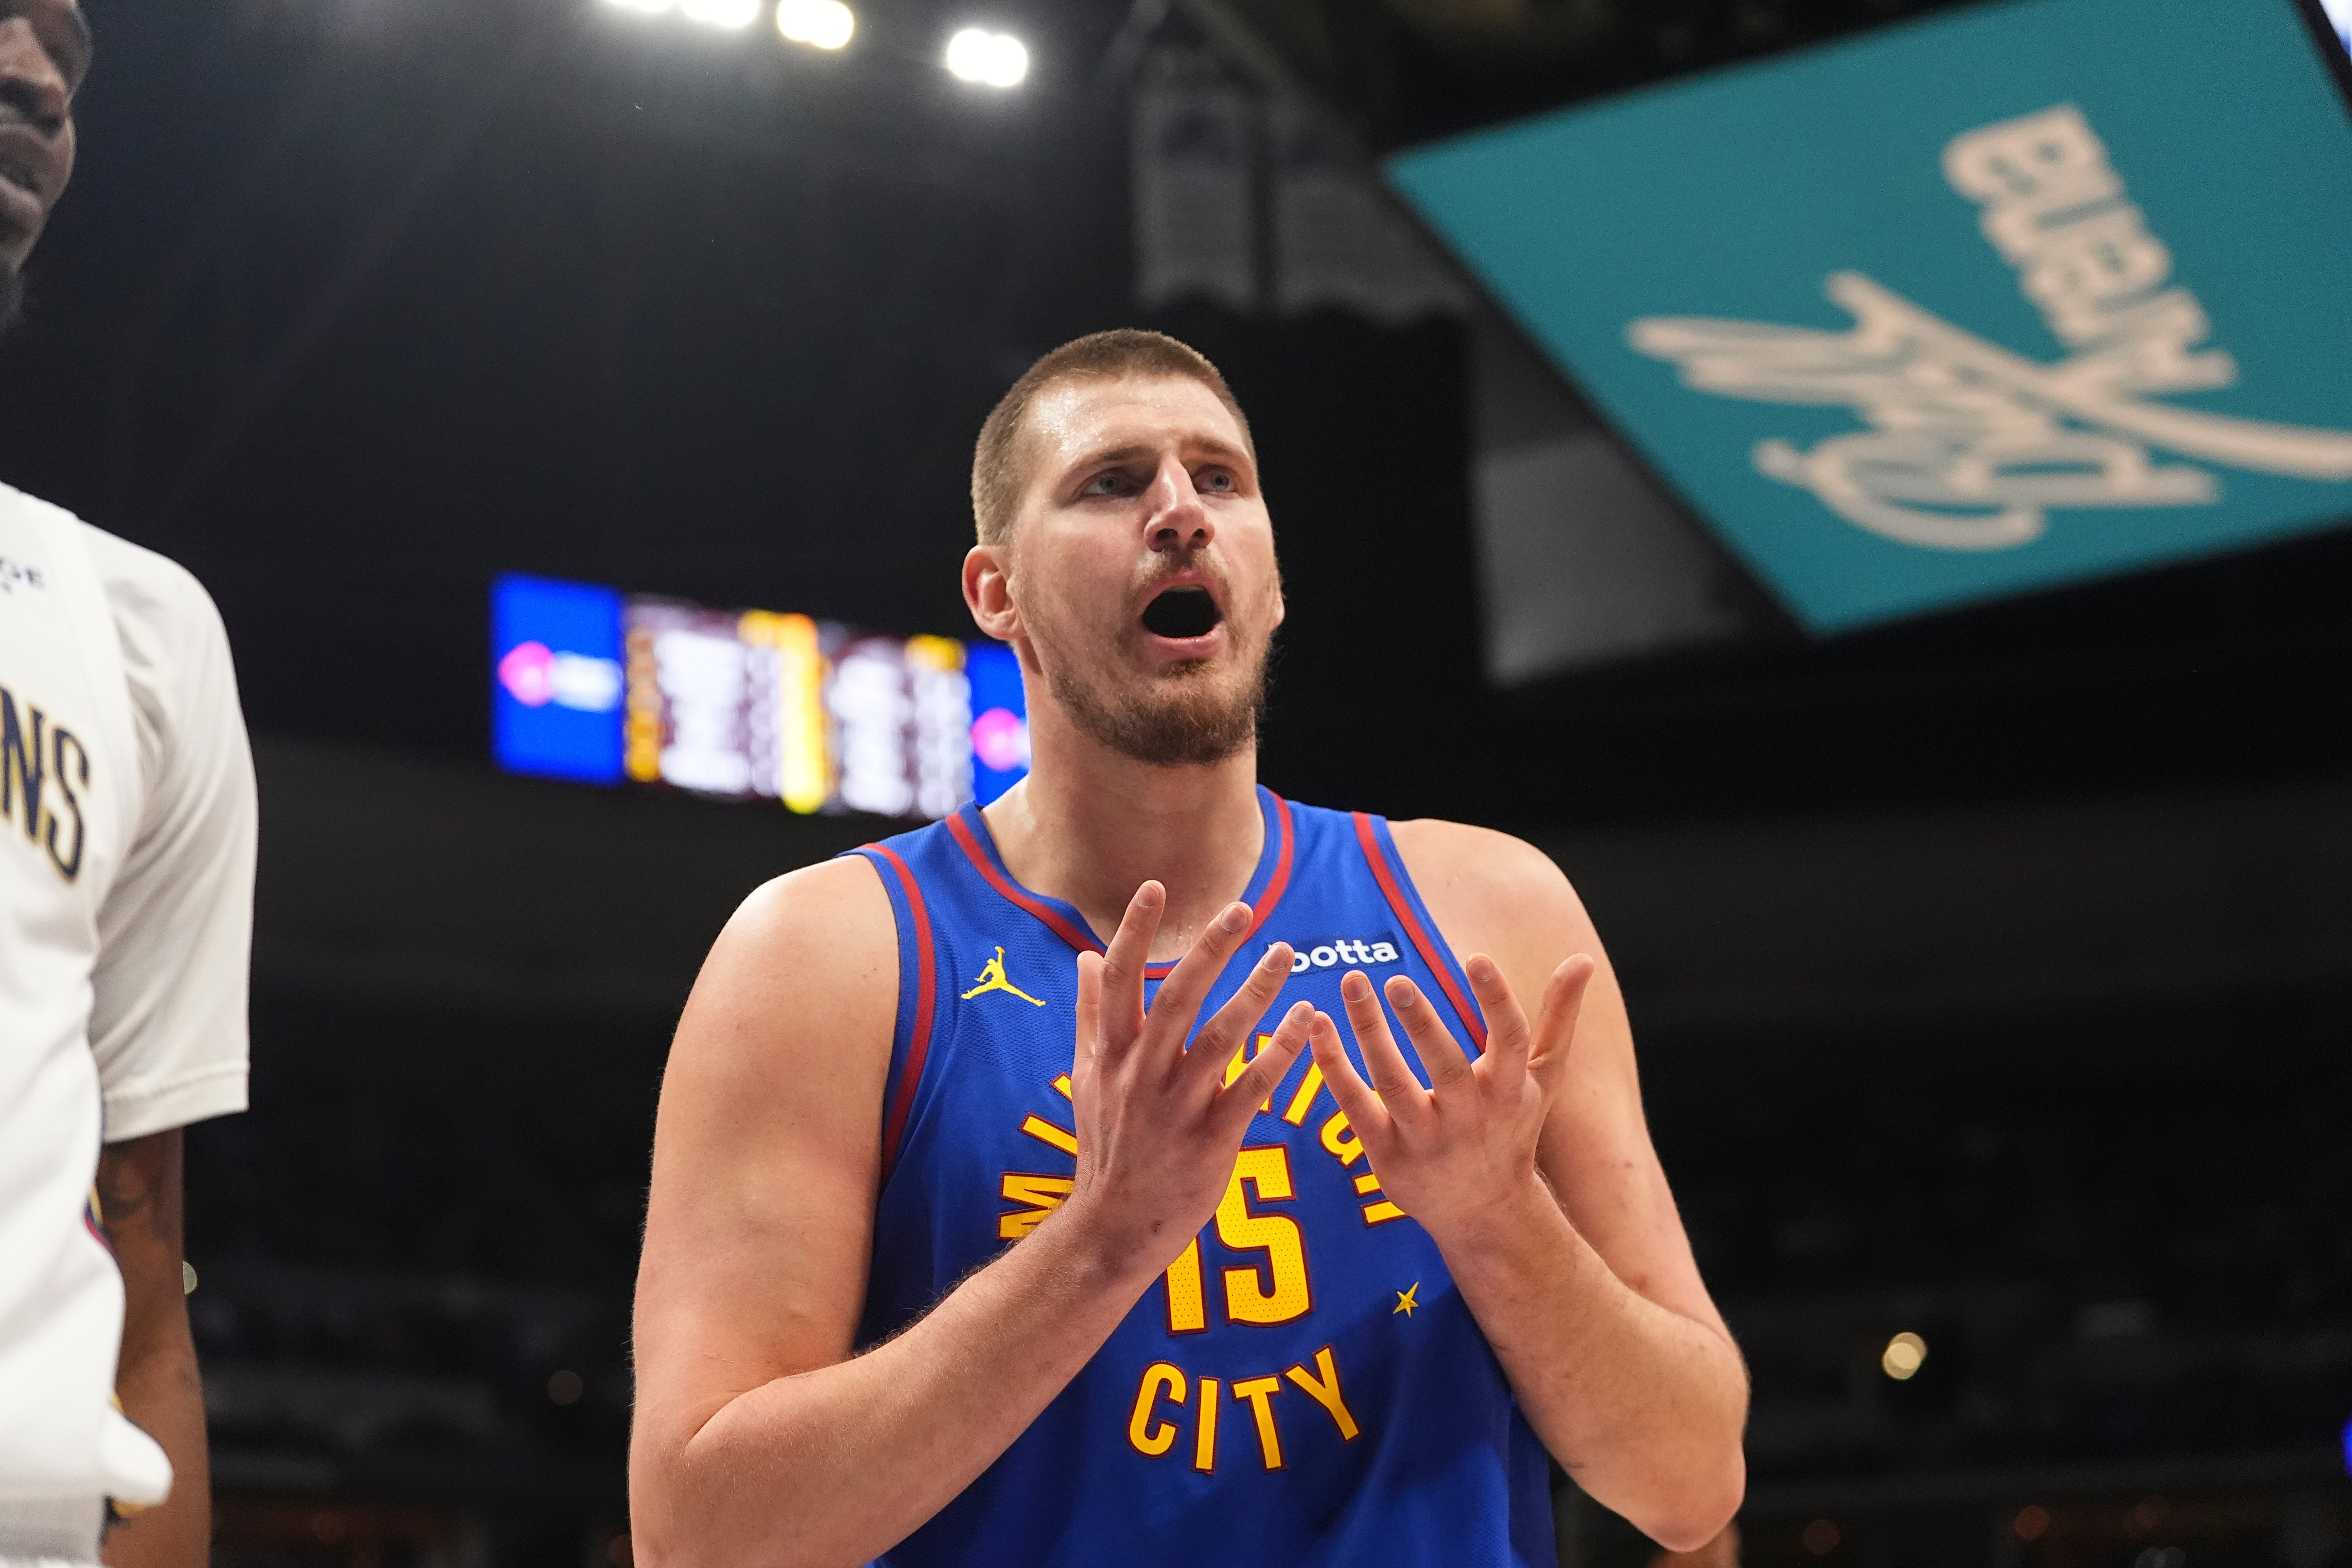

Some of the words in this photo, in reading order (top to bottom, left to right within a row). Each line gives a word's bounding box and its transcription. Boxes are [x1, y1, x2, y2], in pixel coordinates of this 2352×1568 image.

[1941, 102, 2238, 392] Arena
[1268, 939, 1399, 973] otta
[997, 1071, 1078, 1241] MI
[1128, 1343, 1360, 1475] CITY
